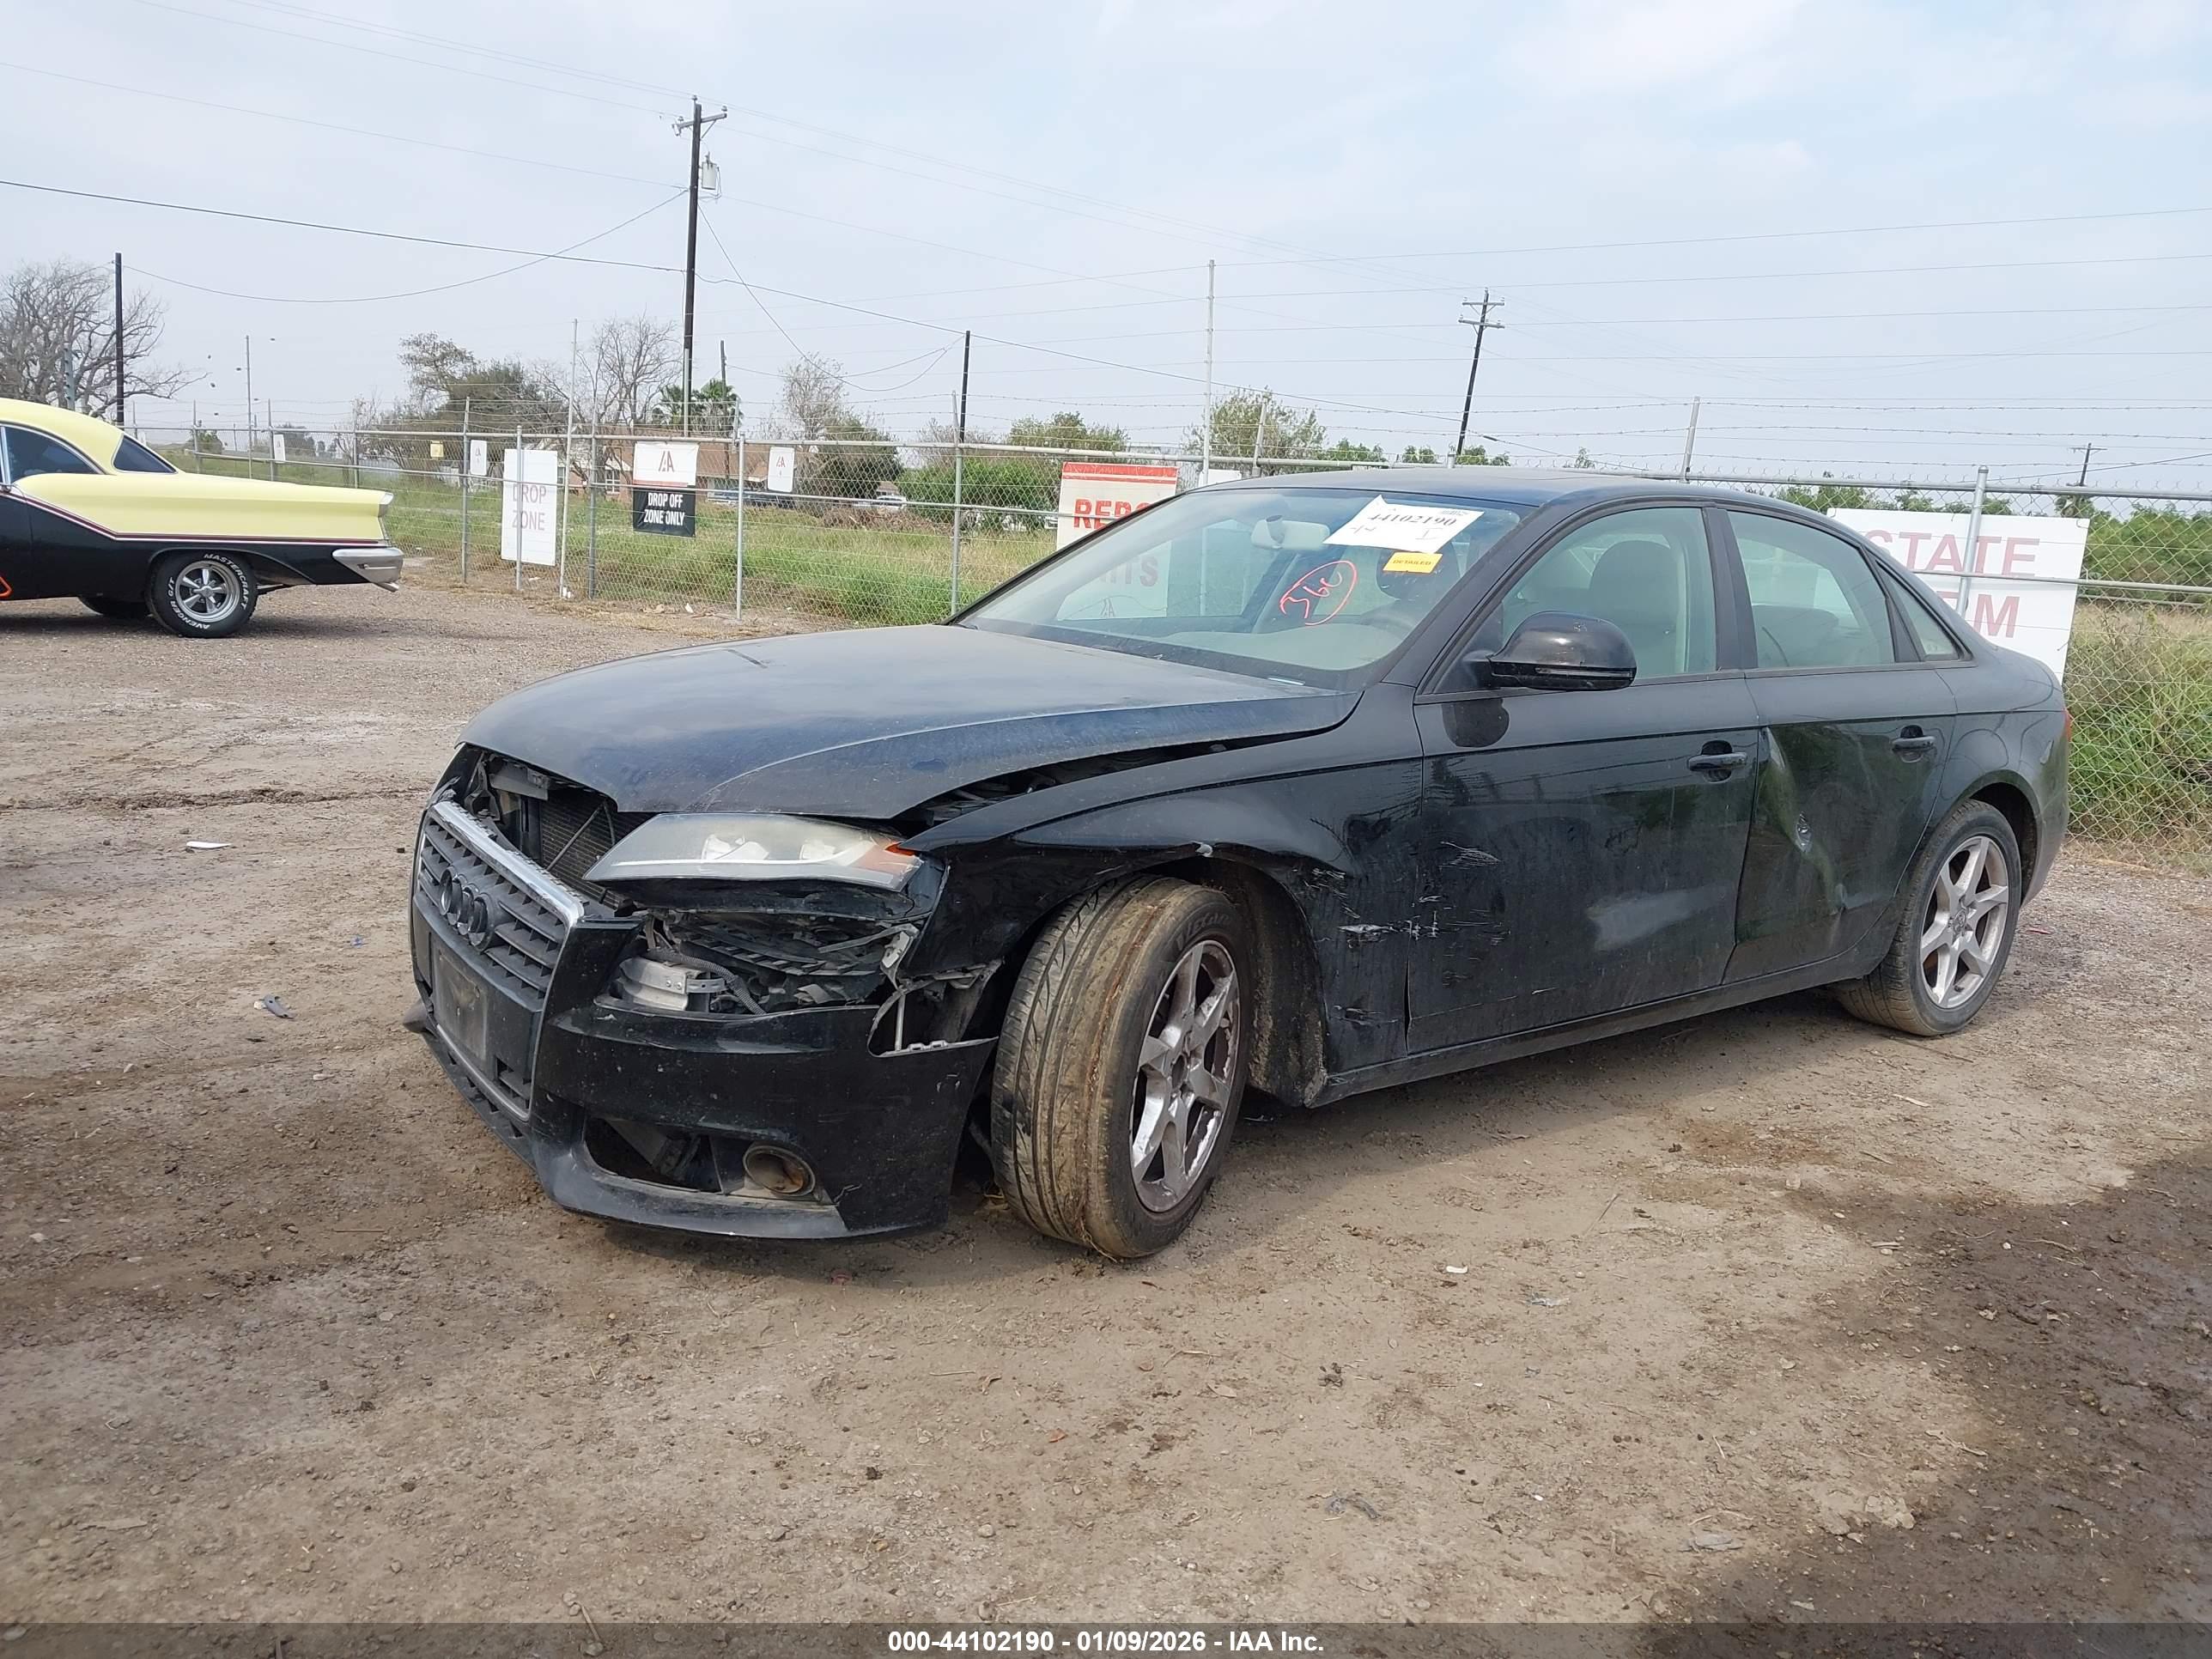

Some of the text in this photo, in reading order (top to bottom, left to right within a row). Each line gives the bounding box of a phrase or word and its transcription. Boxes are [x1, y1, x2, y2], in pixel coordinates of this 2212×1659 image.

[647, 492, 684, 508] DROP OFF
[512, 509, 546, 532] ZONE
[643, 508, 685, 526] ZONE ONLY
[1073, 498, 1152, 530] REP
[1367, 514, 1457, 526] 44102190
[204, 553, 250, 610] MASTERCRAFT
[170, 600, 211, 629] AVENGER
